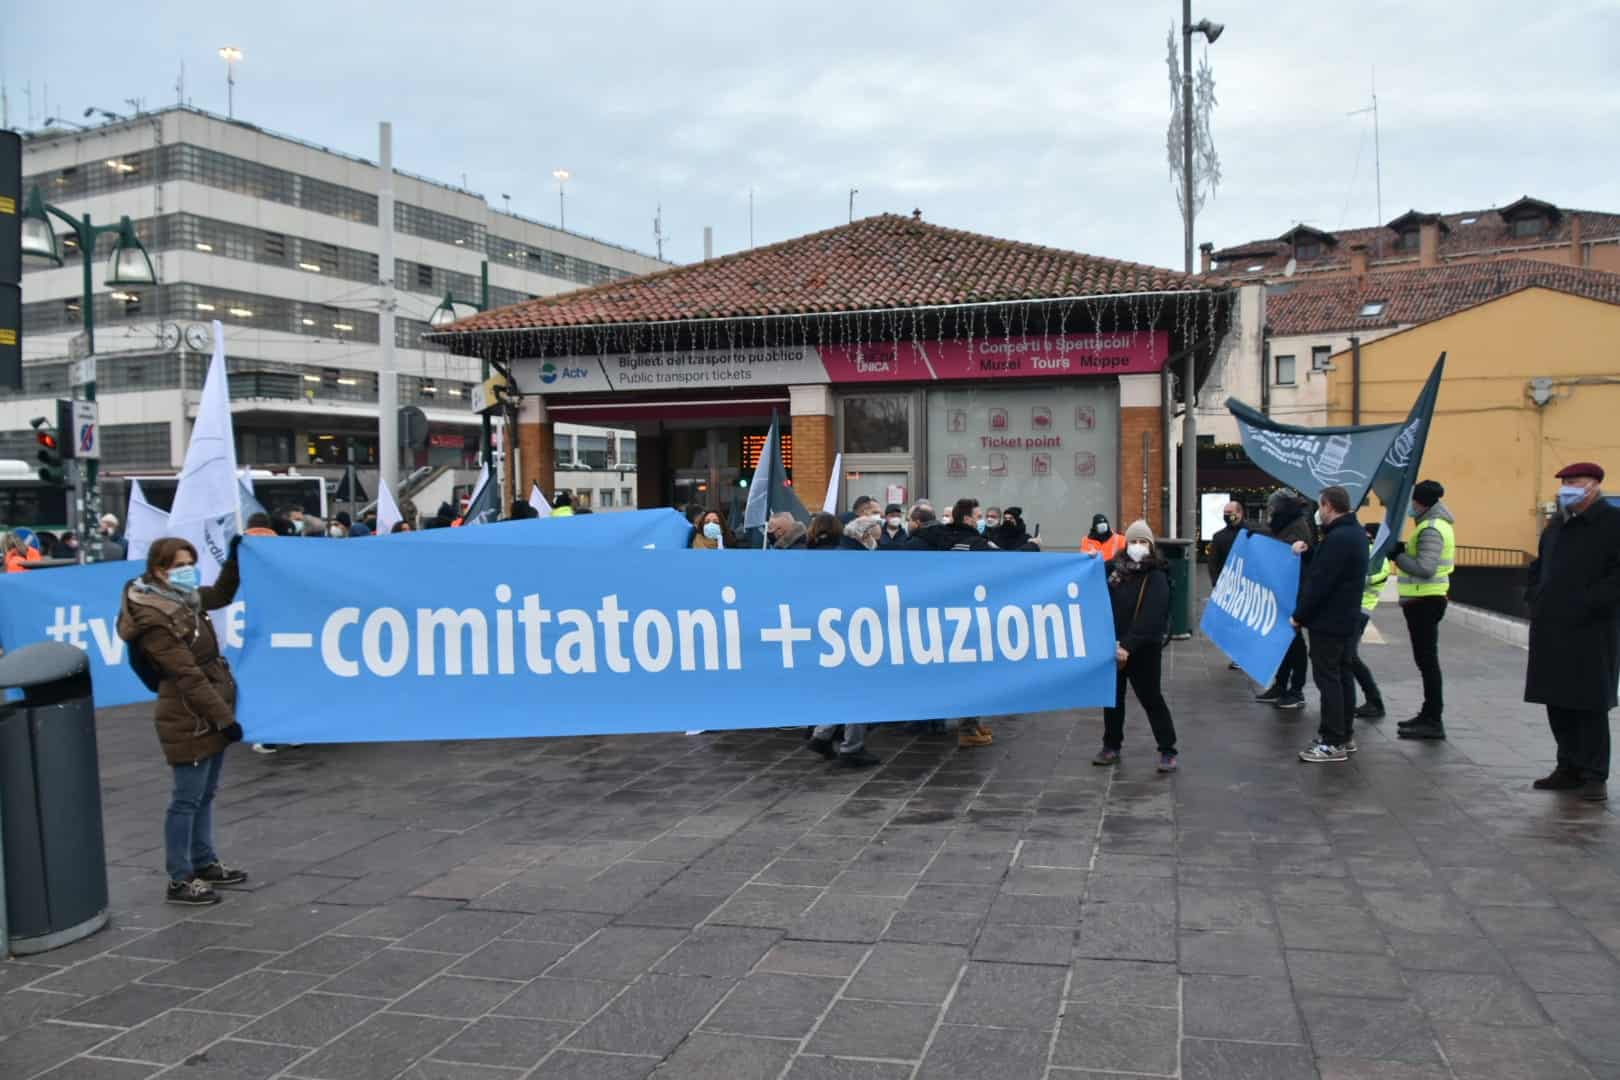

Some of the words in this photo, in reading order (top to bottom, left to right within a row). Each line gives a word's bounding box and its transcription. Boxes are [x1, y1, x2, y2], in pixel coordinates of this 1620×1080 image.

[980, 339, 1040, 354] Concerti
[1055, 335, 1130, 353] Spettacoli
[666, 353, 685, 366] del
[688, 353, 746, 368] trasporto
[750, 351, 804, 366] pubblico
[980, 359, 1020, 371] Musei
[1030, 356, 1070, 369] Tours
[1080, 355, 1129, 369] Mappe
[561, 367, 587, 379] Actv
[619, 370, 654, 384] Public
[656, 369, 709, 385] transport
[712, 368, 752, 381] tickets
[980, 435, 1022, 448] Ticket
[1025, 434, 1061, 450] point
[760, 582, 1087, 669] +soluzioni
